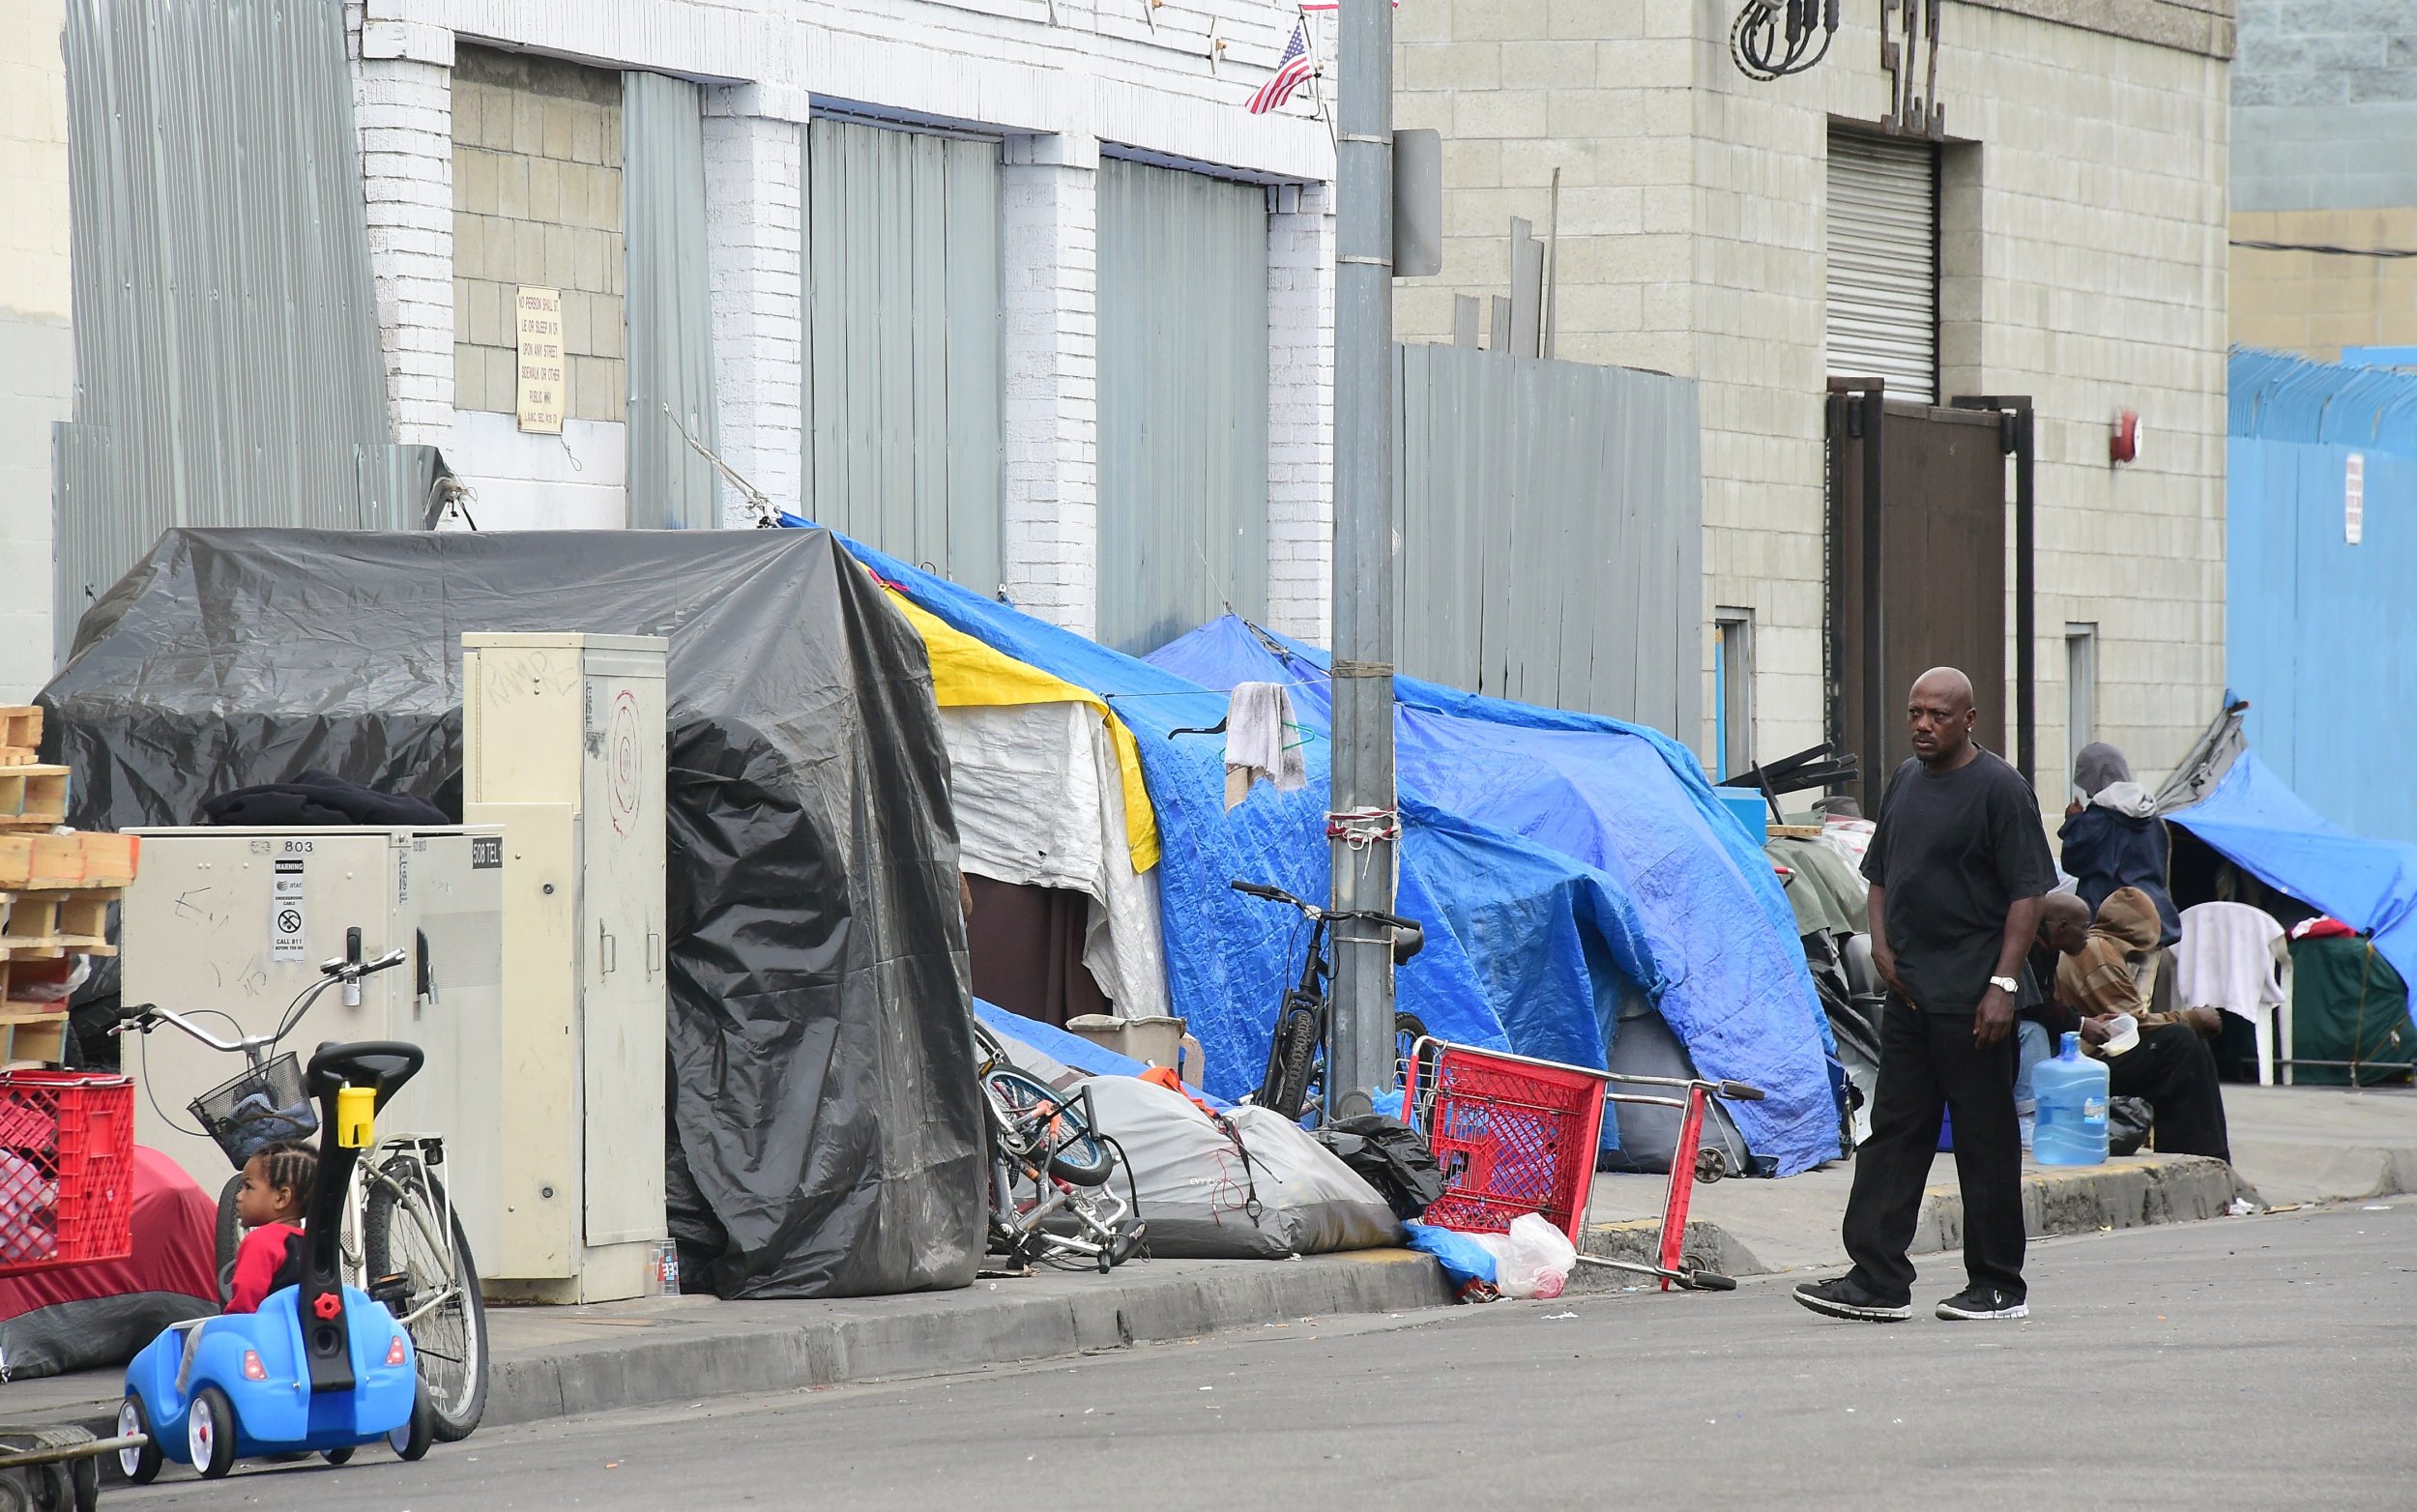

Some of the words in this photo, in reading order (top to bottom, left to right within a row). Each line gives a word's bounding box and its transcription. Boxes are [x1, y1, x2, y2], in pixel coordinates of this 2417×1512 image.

[525, 296, 541, 310] PERSON
[528, 319, 535, 334] OR
[536, 319, 547, 334] SLEEP
[523, 342, 533, 357] UPON
[534, 343, 543, 357] ANY
[521, 365, 539, 380] SIDEWALK
[540, 366, 547, 381] OR
[547, 367, 560, 382] OTHER
[529, 390, 543, 403] PUBLIC
[284, 840, 313, 853] 803
[473, 843, 485, 864] 508
[485, 842, 499, 863] TEL
